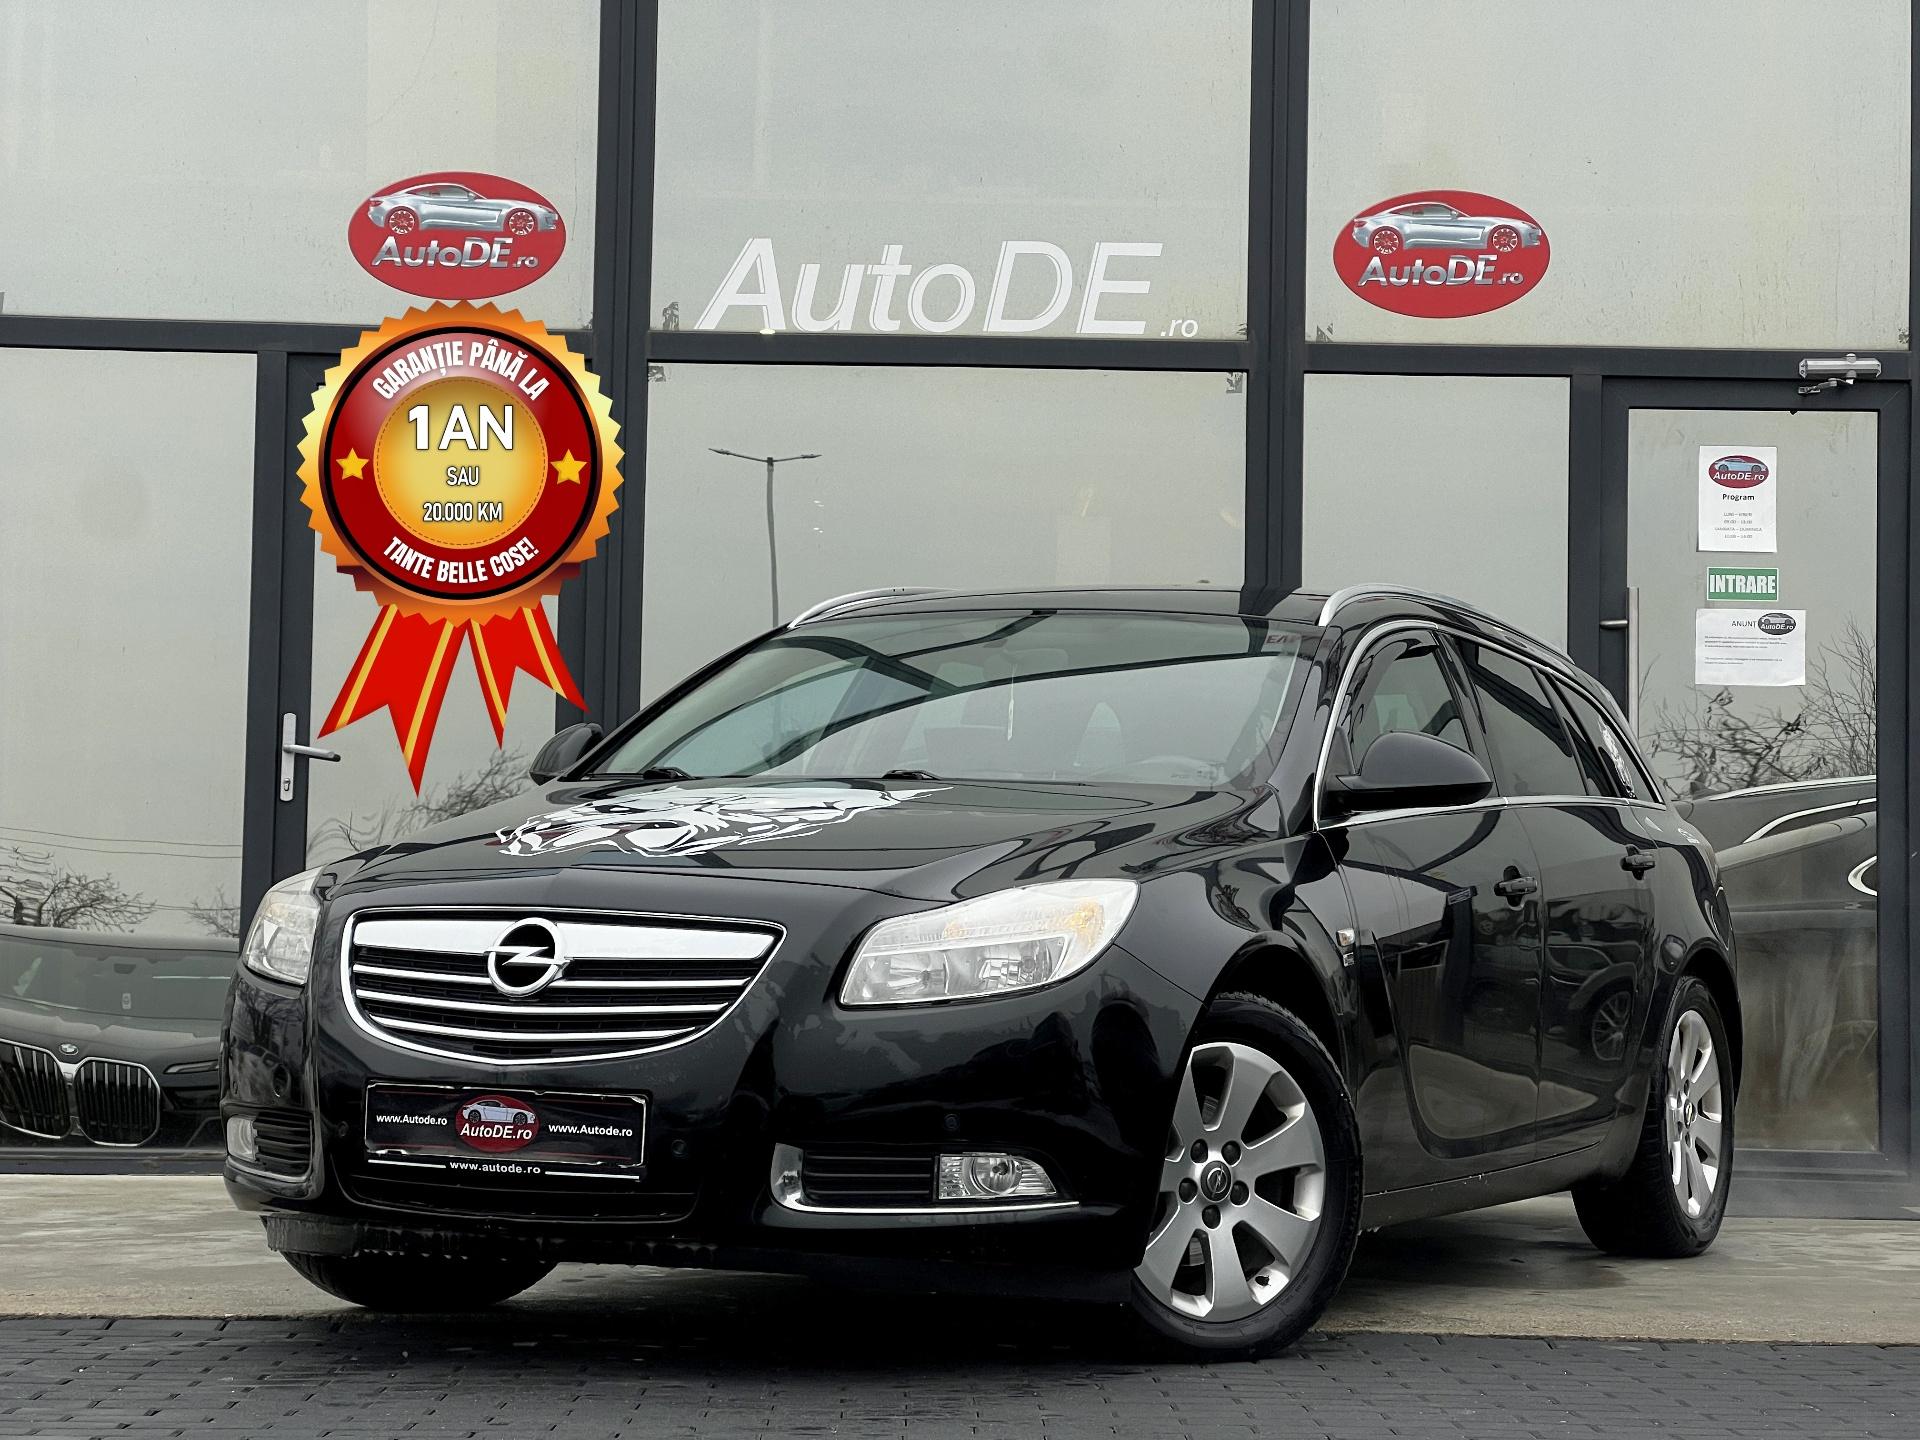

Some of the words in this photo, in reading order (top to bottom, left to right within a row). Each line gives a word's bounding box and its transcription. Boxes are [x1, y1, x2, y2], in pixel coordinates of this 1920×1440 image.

[1712, 471, 1766, 482] AutoDE.ro
[1721, 493, 1755, 503] Program
[1709, 574, 1776, 594] INTRARE
[375, 1113, 448, 1126] www.Autode.ro
[460, 1122, 532, 1140] AutoDE.ro
[548, 1123, 633, 1137] www.Autode.ro
[449, 1161, 541, 1174] www.autode.ro
